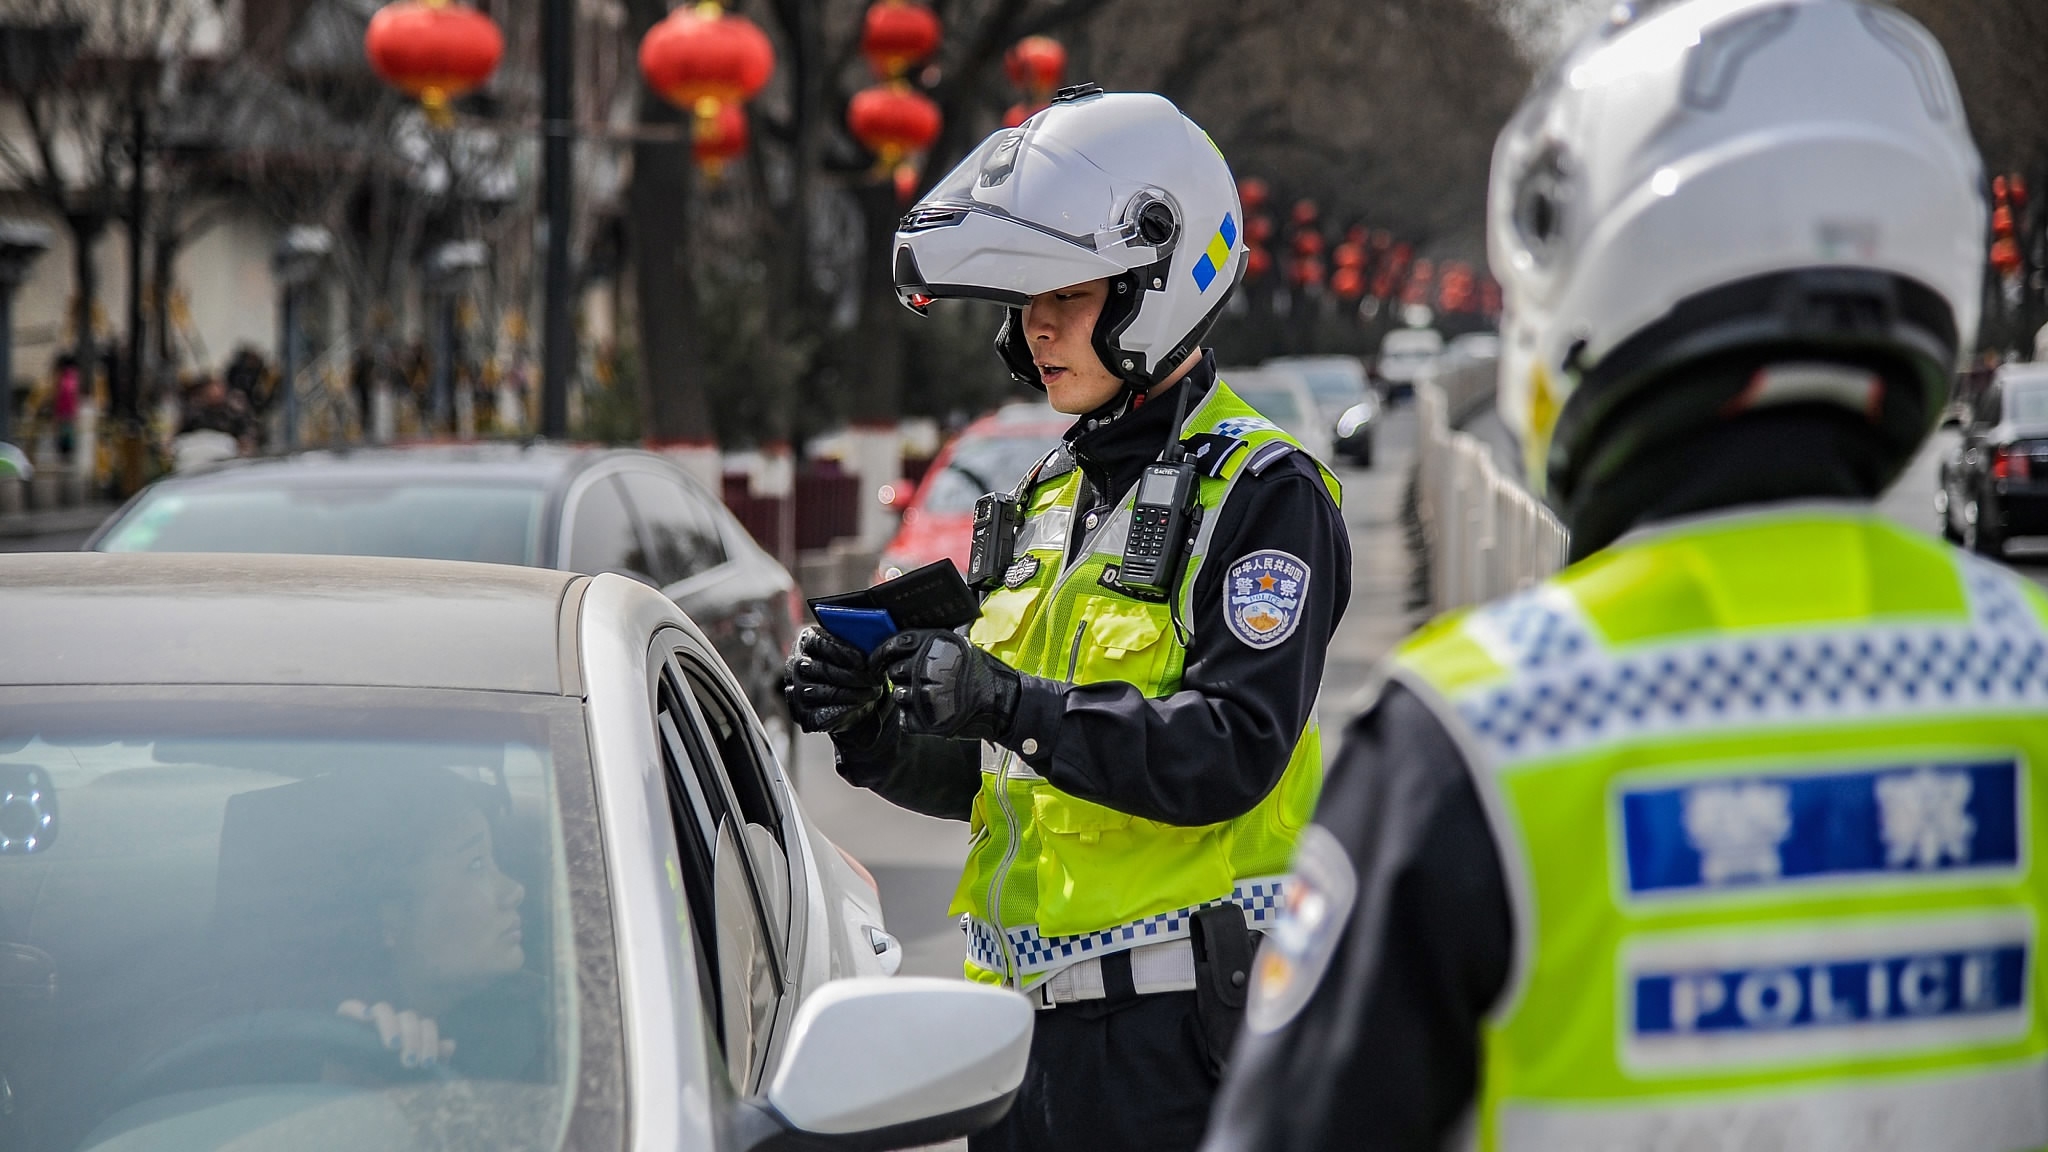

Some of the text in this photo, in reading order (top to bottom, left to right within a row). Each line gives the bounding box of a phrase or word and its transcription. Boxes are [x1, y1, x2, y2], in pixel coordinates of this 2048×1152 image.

[1232, 557, 1303, 582] 中华人民共和国
[1235, 577, 1297, 597] 警察
[1249, 594, 1281, 604] POLICE
[1669, 956, 1998, 1031] POLICE
